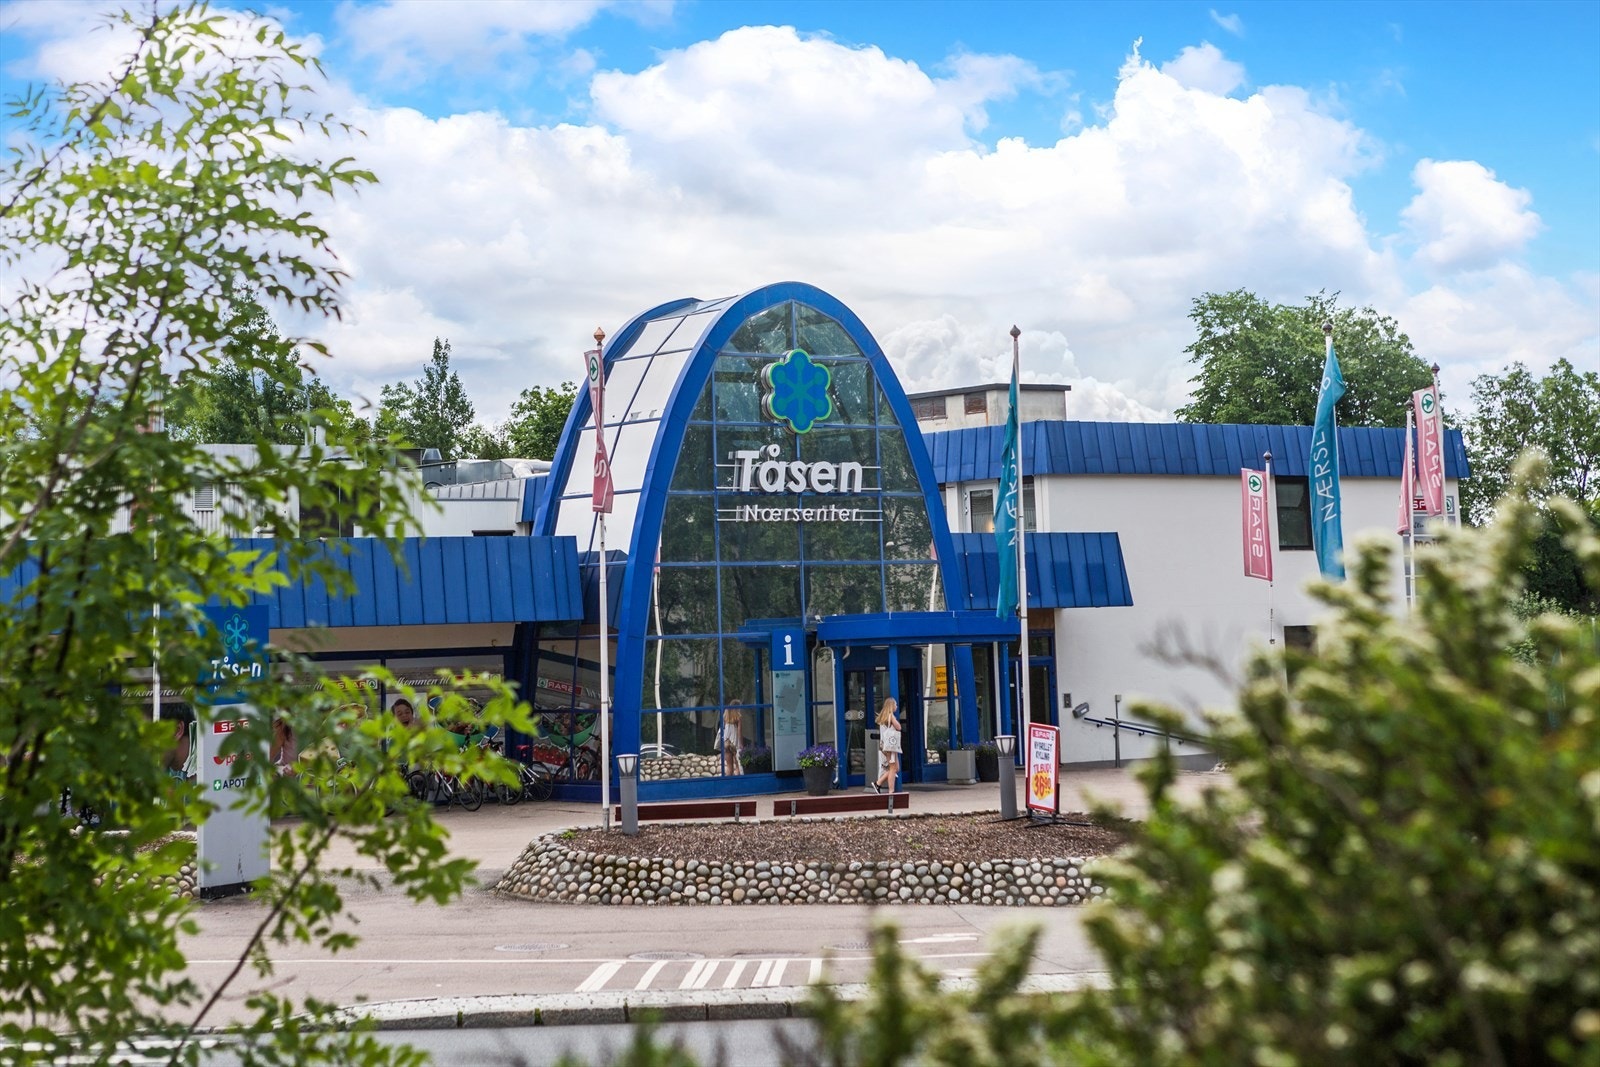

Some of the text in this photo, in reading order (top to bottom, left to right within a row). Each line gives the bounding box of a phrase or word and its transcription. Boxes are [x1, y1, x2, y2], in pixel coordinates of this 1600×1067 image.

[736, 444, 863, 493] Tåsen
[744, 504, 860, 522] Nærsenter
[784, 635, 794, 665] i
[221, 720, 250, 732] SPR
[222, 777, 256, 789] APOT
